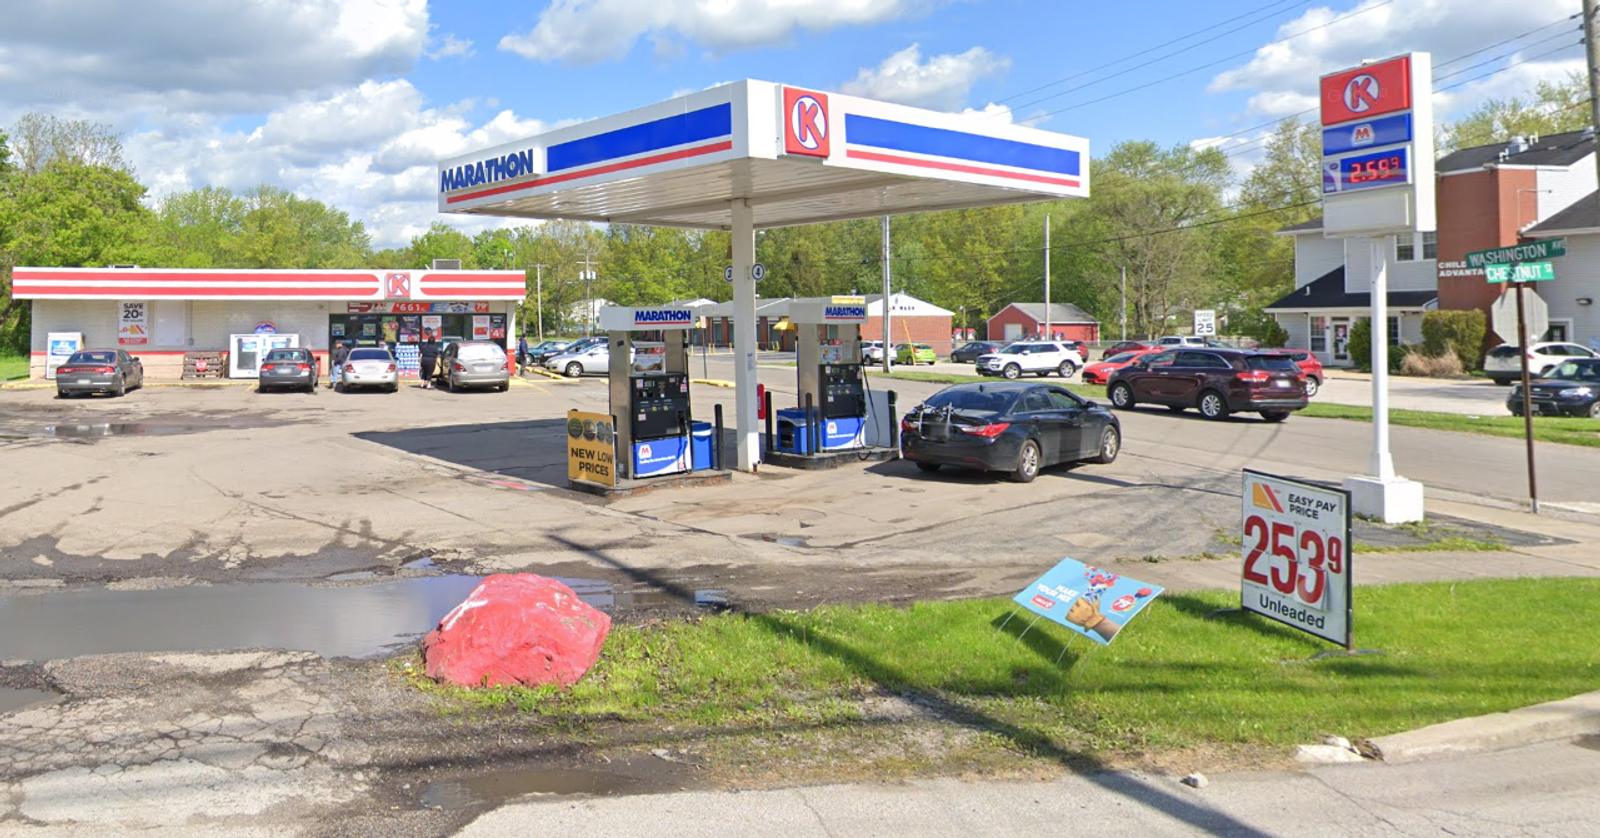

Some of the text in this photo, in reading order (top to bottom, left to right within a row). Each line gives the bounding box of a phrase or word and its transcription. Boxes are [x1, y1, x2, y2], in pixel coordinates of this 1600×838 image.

[440, 148, 534, 193] MARATHON
[1469, 244, 1547, 266] WASHINGTON
[755, 267, 761, 276] 4
[1438, 268, 1485, 277] ADVANTA
[1486, 265, 1542, 280] CHESTNUT
[635, 311, 692, 322] MARATHON
[825, 307, 865, 317] MARATHON
[1197, 323, 1214, 333] 25
[571, 448, 613, 464] NEW LOW
[578, 462, 609, 476] PRICES
[1288, 493, 1337, 512] EASY PAY
[1289, 504, 1319, 519] PRICE
[1037, 584, 1058, 597] YOUR
[1055, 585, 1079, 598] MAKE
[1260, 594, 1326, 630] Unleaded
